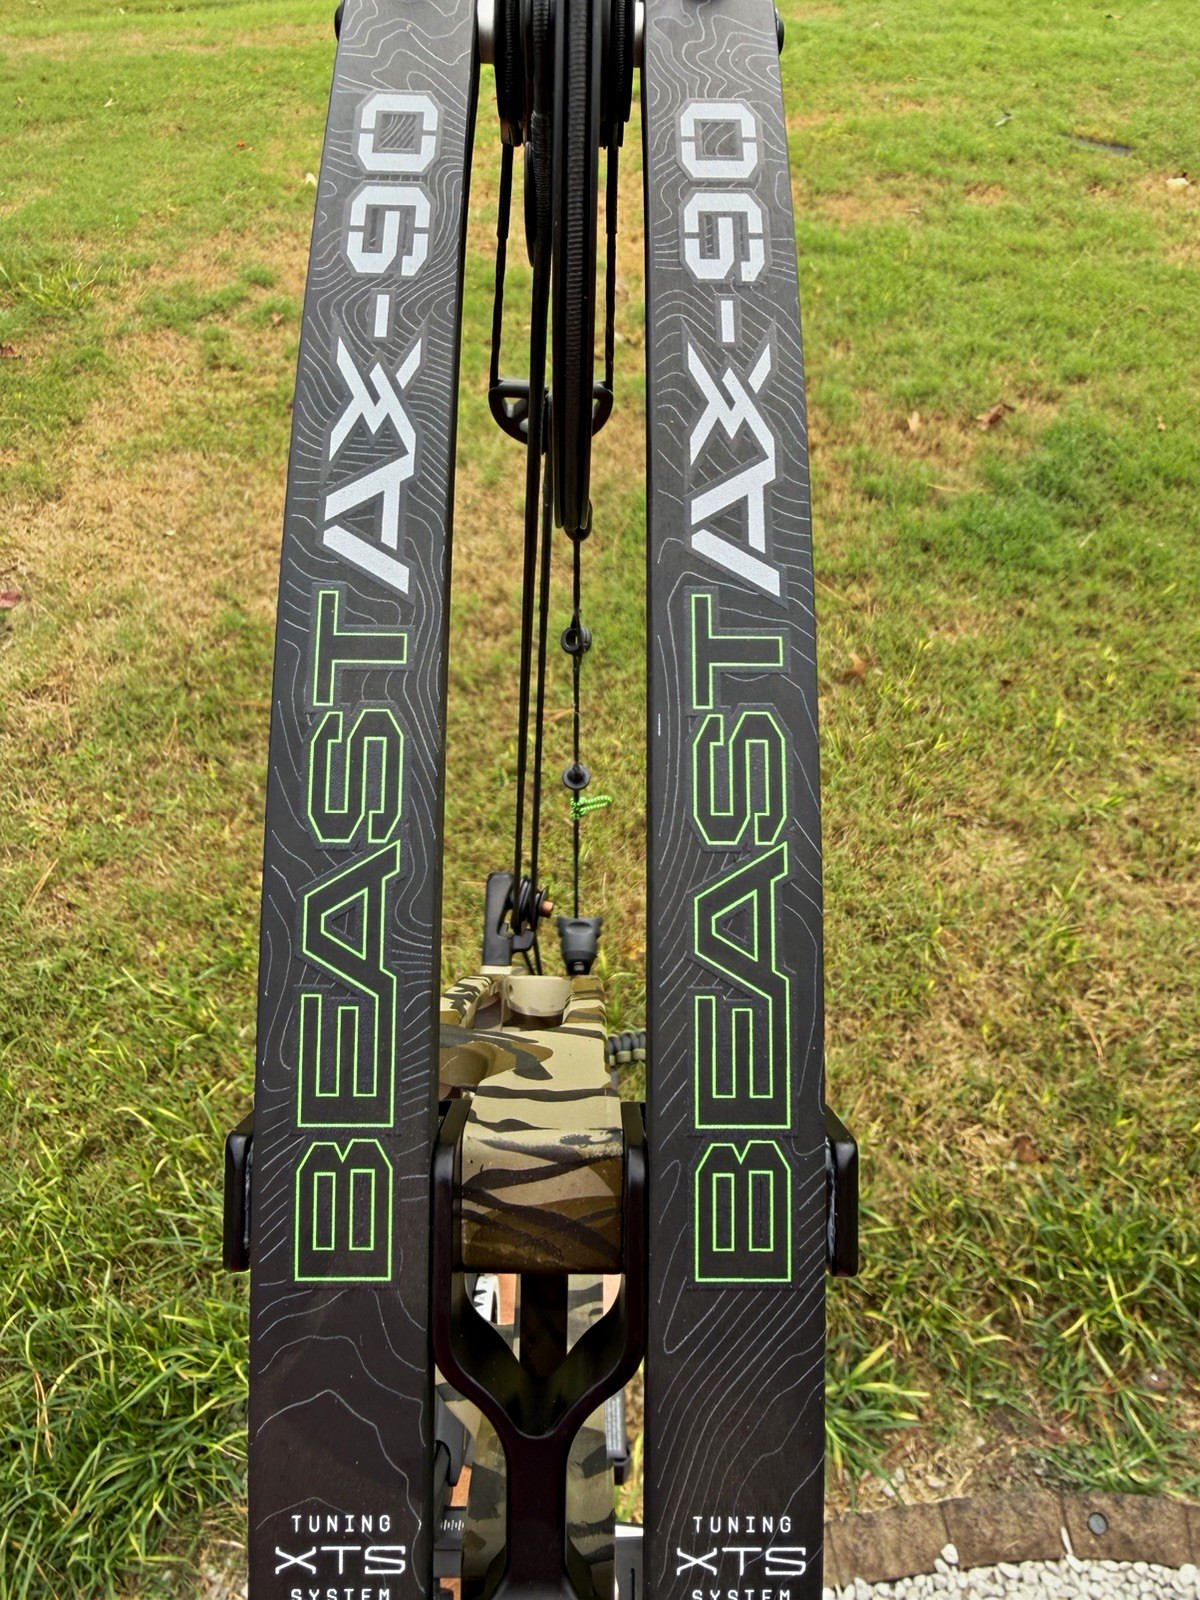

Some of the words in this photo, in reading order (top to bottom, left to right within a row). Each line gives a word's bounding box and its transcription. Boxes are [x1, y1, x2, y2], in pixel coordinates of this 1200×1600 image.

[291, 1514, 391, 1533] TUNING
[692, 1515, 792, 1534] TUNING
[274, 1545, 407, 1575] XTS
[676, 1546, 807, 1577] XTS
[290, 1588, 390, 1600] SYSTEM
[691, 1589, 791, 1600] SYSTEM
